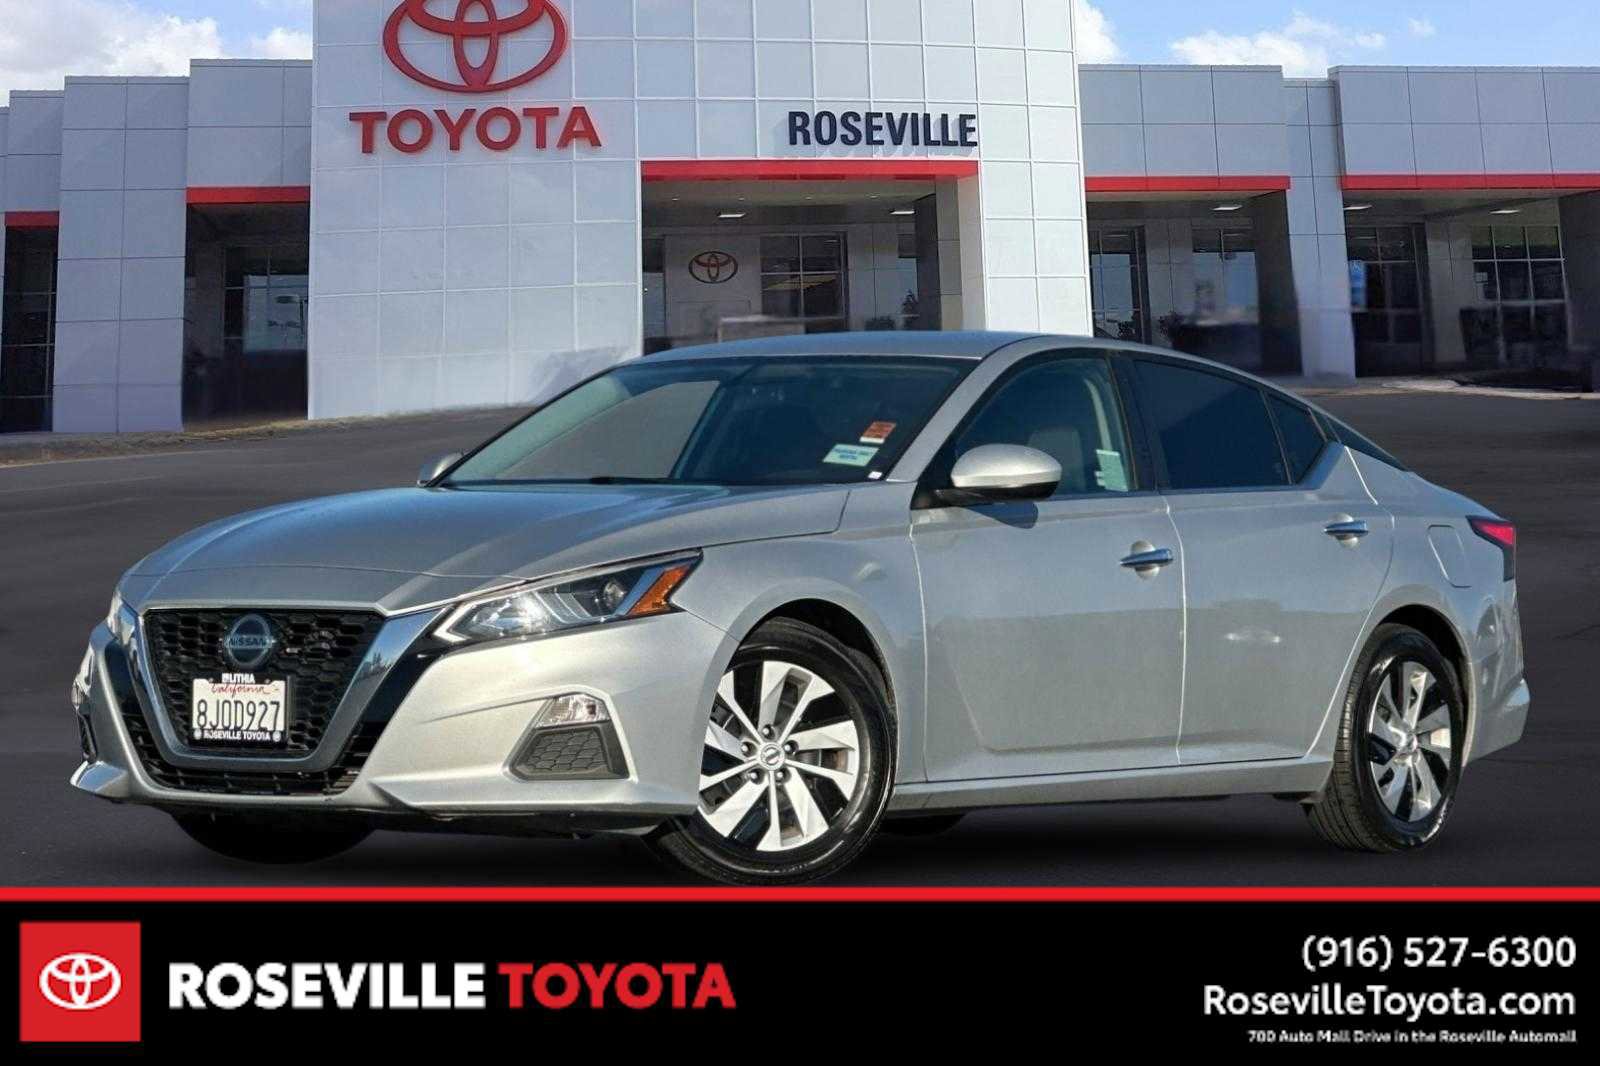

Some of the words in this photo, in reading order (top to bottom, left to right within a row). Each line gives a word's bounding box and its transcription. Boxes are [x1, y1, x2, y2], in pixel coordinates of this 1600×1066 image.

[349, 106, 602, 154] TOYOTA
[788, 110, 978, 147] ROSEVILLE
[228, 637, 268, 647] NISSAN
[210, 683, 271, 698] California
[203, 730, 242, 740] ROSEVILLE
[243, 731, 271, 741] TOYOTA
